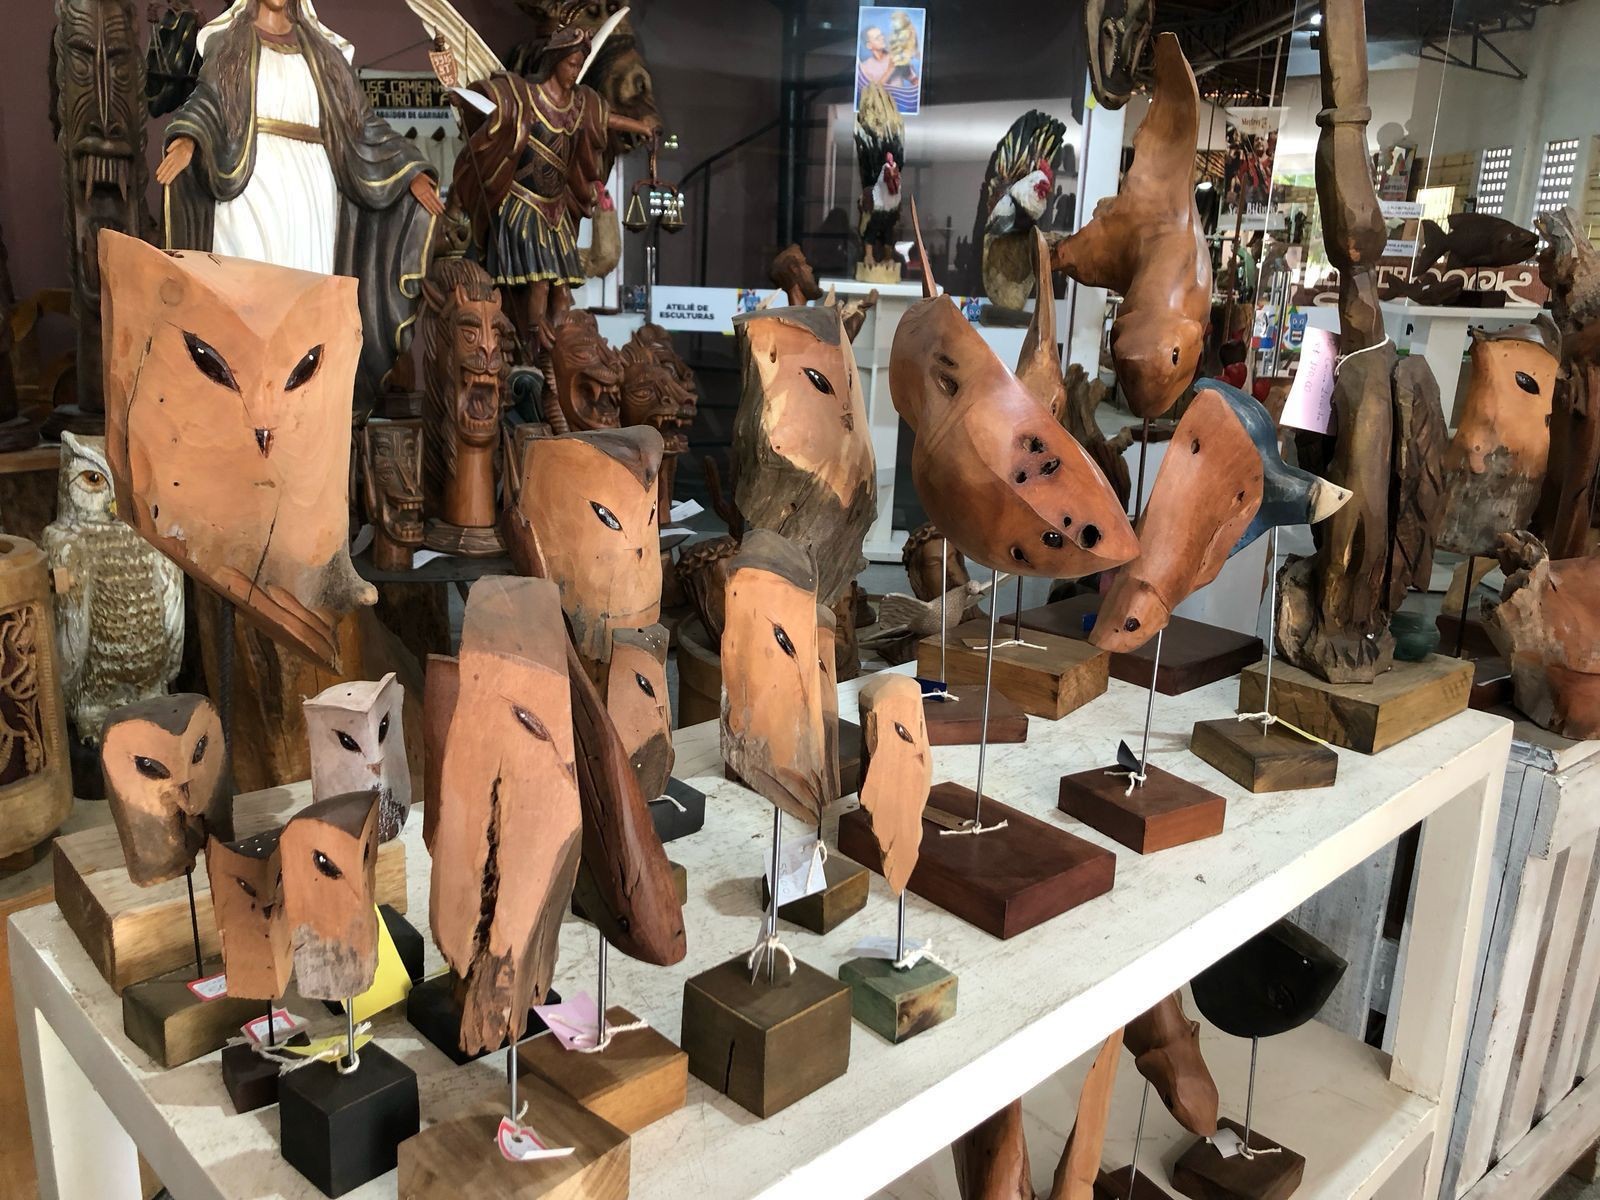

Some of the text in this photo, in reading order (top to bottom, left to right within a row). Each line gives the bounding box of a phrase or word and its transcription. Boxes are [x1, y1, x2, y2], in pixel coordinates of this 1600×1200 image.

[362, 80, 386, 93] USE
[384, 93, 412, 107] TIRO
[415, 93, 433, 107] NA
[408, 111, 417, 119] DE
[418, 111, 449, 119] GARRAFA
[659, 312, 714, 320] ESCULTURAS
